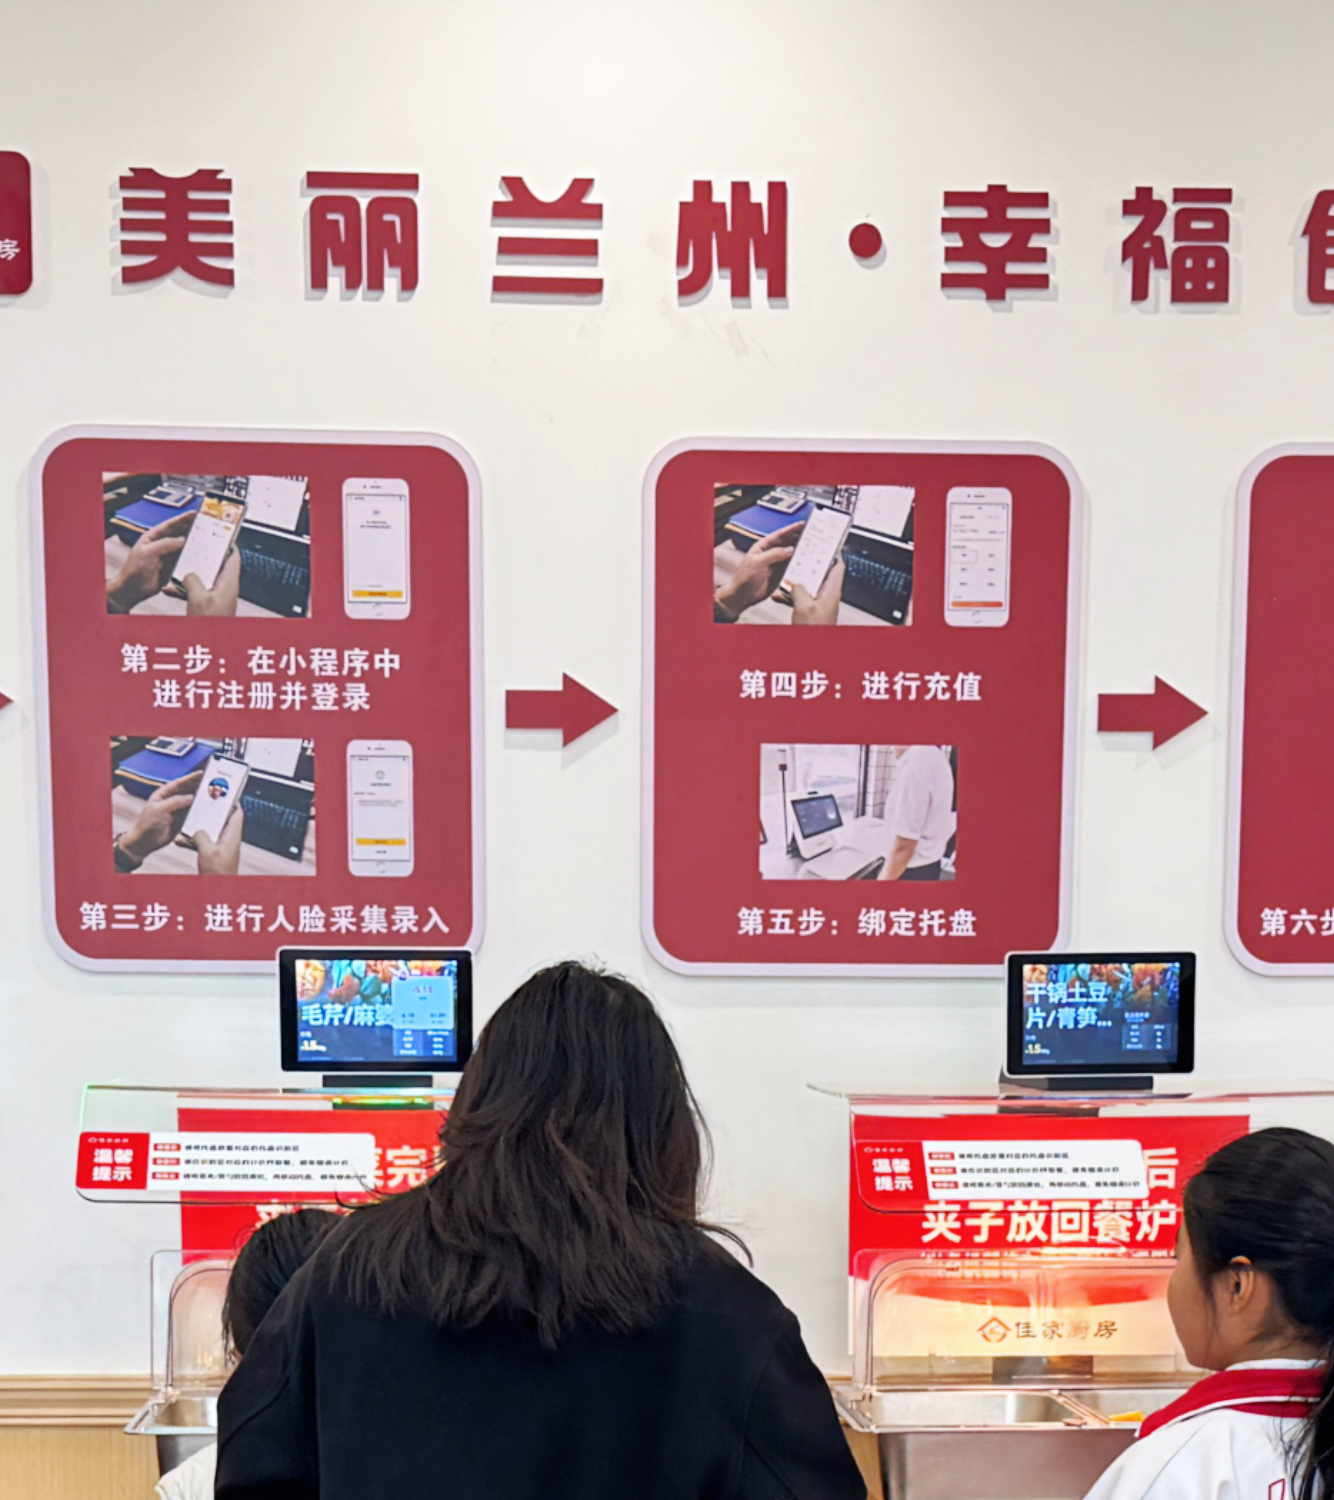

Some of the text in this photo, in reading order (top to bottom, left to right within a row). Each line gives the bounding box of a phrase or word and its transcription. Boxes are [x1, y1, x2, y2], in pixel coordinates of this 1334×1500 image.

[120, 644, 402, 678] 第二步：在小程序中
[152, 680, 372, 712] 进行注册并登录
[738, 669, 983, 702] 第四步：进行充值
[79, 902, 451, 935] 第三步：进行人脸采集录入
[737, 907, 978, 937] 第五步：绑定托盘
[1025, 980, 1108, 1004] 干锅土豆
[92, 1166, 133, 1183] 提示
[875, 1176, 914, 1192] 提示
[921, 1198, 1179, 1244] 夹子放回餐炉
[1014, 1319, 1118, 1341] 佳家厨房
